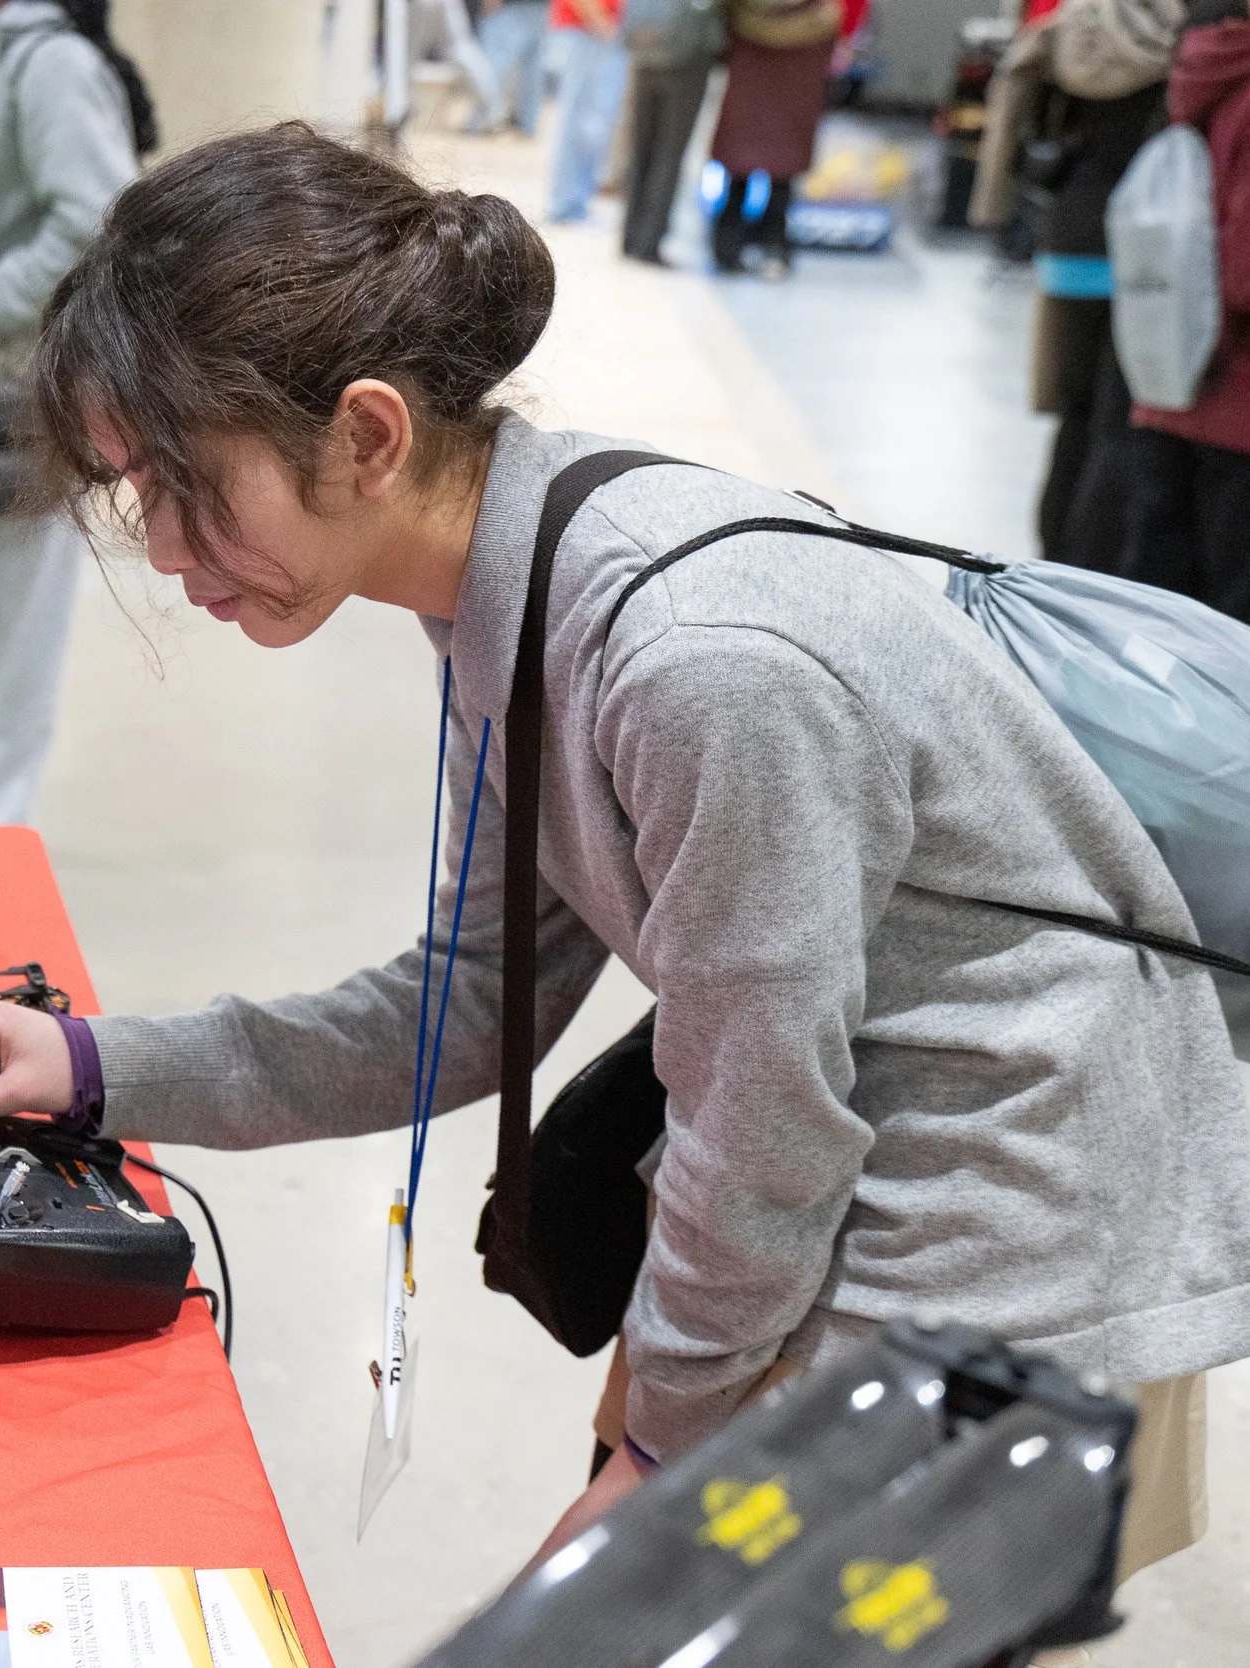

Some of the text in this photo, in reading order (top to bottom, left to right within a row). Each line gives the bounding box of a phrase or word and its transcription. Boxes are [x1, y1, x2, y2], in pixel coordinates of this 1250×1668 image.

[392, 1306, 402, 1352] TOWSON
[62, 1576, 76, 1600] AND
[77, 1572, 94, 1617] CENTER
[119, 1580, 134, 1620] ADVANCING
[66, 1604, 84, 1657] RESEARCH
[138, 1600, 152, 1640] INNOVATION
[211, 1602, 229, 1642] INNOVATION
